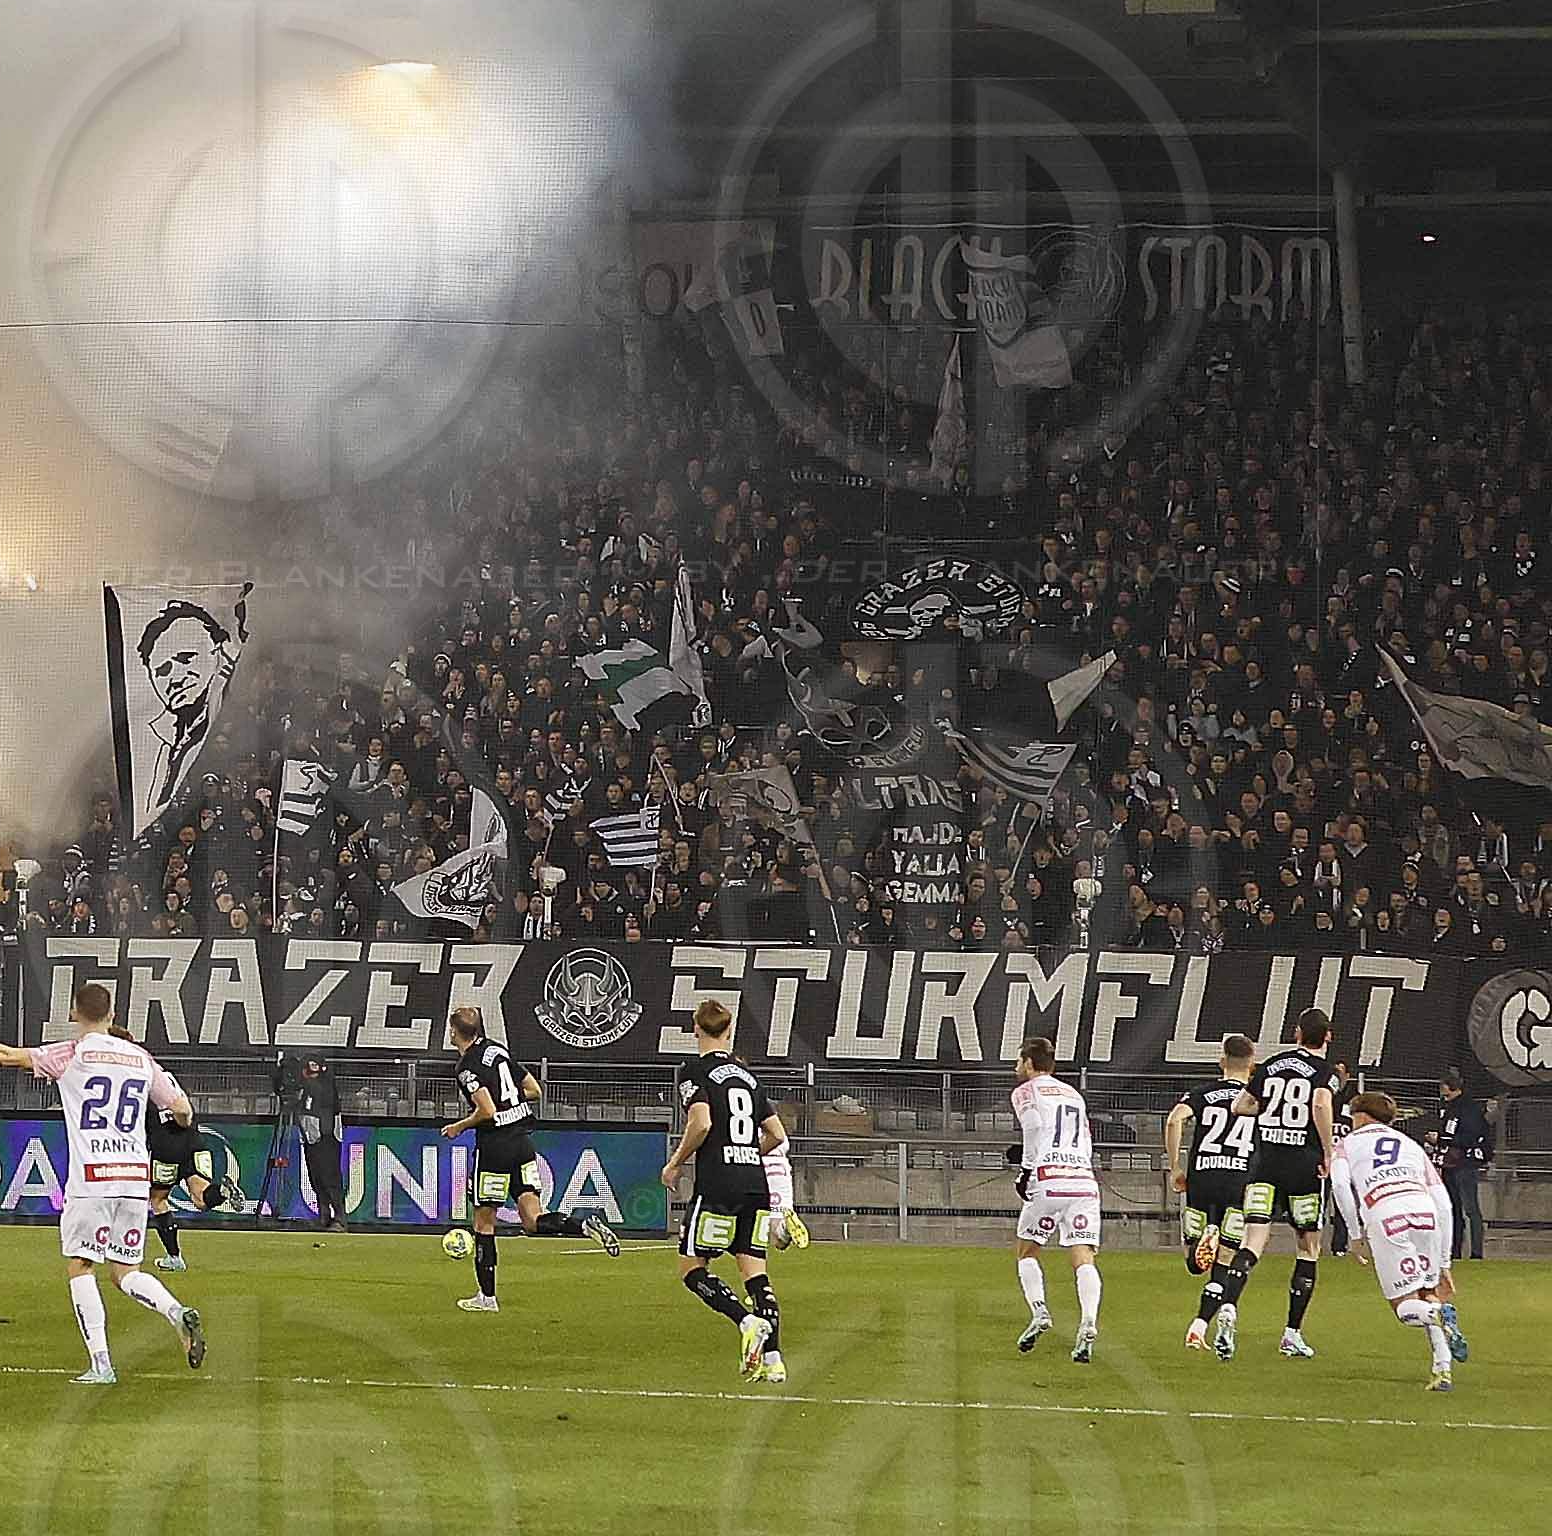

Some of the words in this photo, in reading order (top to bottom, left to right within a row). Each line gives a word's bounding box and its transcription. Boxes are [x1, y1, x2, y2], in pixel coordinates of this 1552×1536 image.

[856, 560, 972, 617] GRAZER
[40, 937, 524, 1050] GRAZER
[658, 946, 1430, 1067] STURMFLUT
[542, 1017, 581, 1046] GRAZER
[80, 1076, 146, 1133] 26
[498, 1061, 520, 1107] 4
[1258, 1076, 1312, 1128] 28
[728, 1087, 754, 1145] 8
[1052, 1104, 1080, 1148] 17
[1198, 1105, 1256, 1158] 24
[1373, 1137, 1402, 1169] 9
